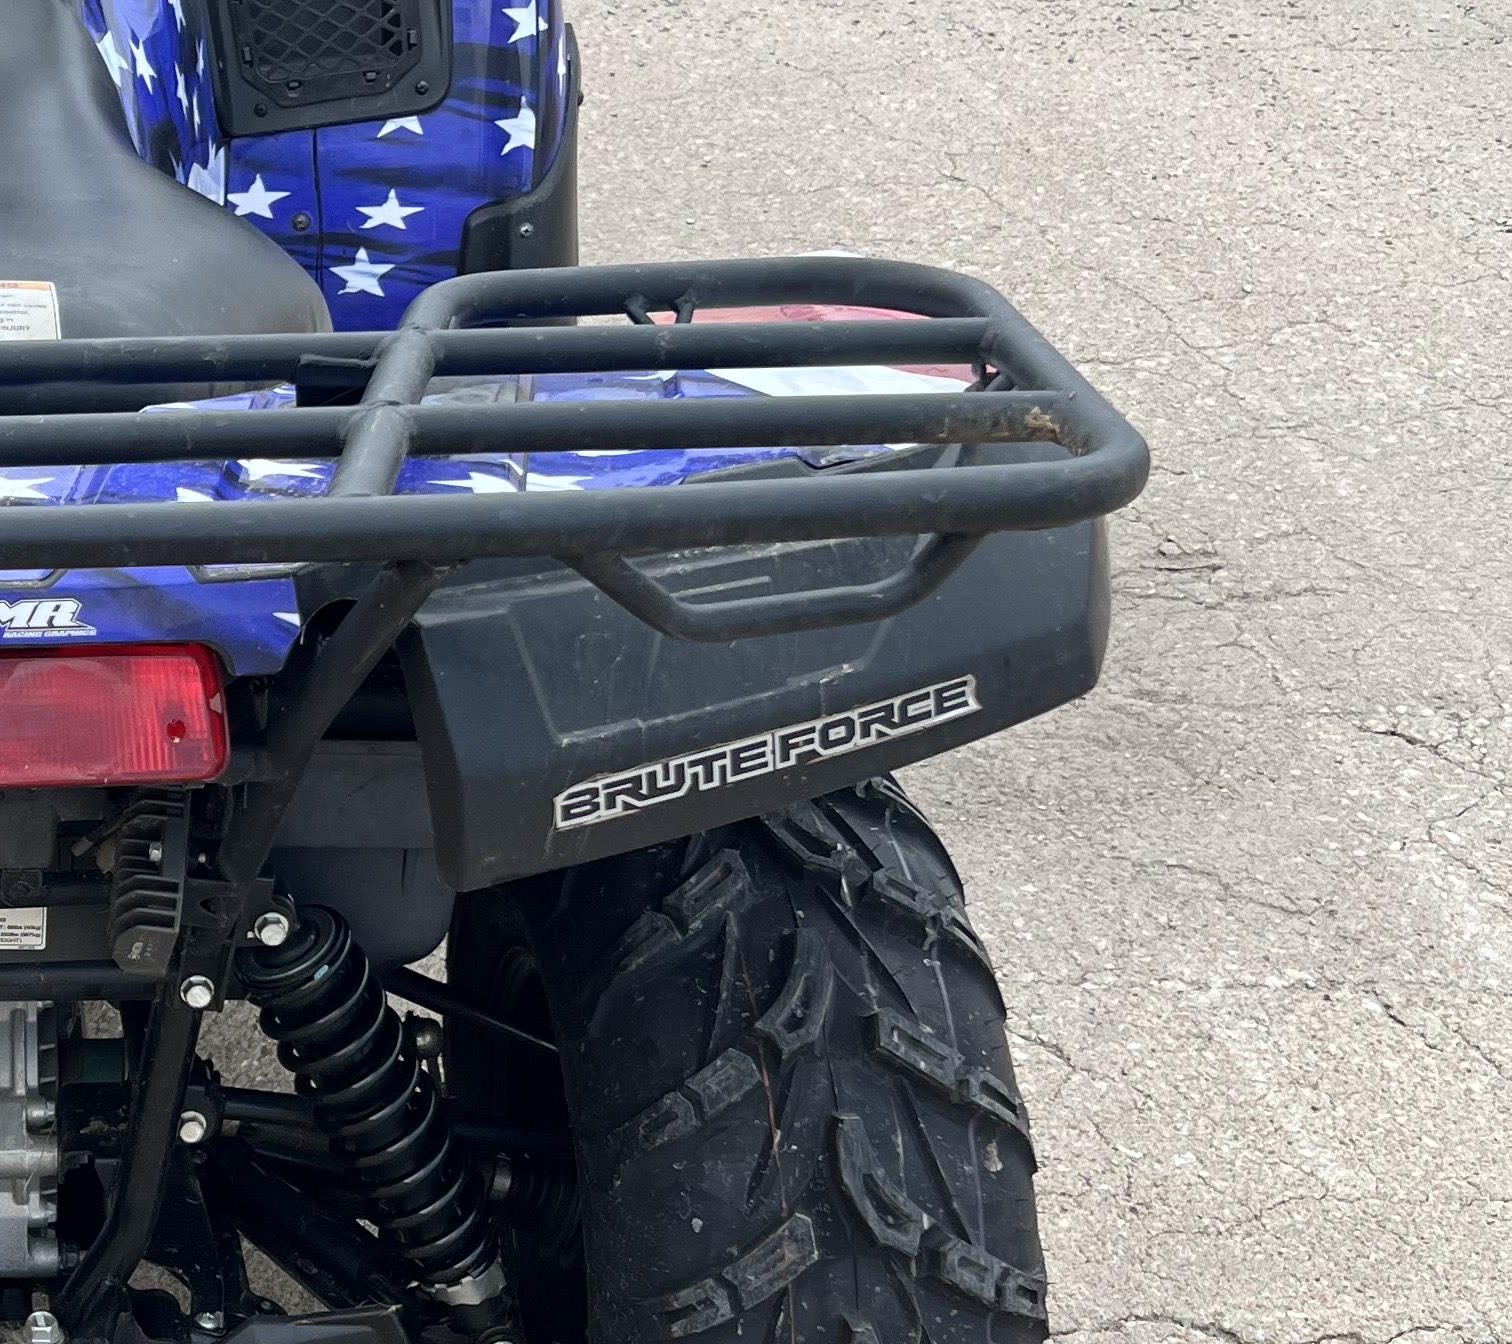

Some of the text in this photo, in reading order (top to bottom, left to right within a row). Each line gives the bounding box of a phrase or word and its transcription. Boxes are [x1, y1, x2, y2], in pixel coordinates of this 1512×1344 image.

[3, 629, 97, 638] RACING GRAPHICS
[558, 678, 974, 825] BRUTE FORCE
